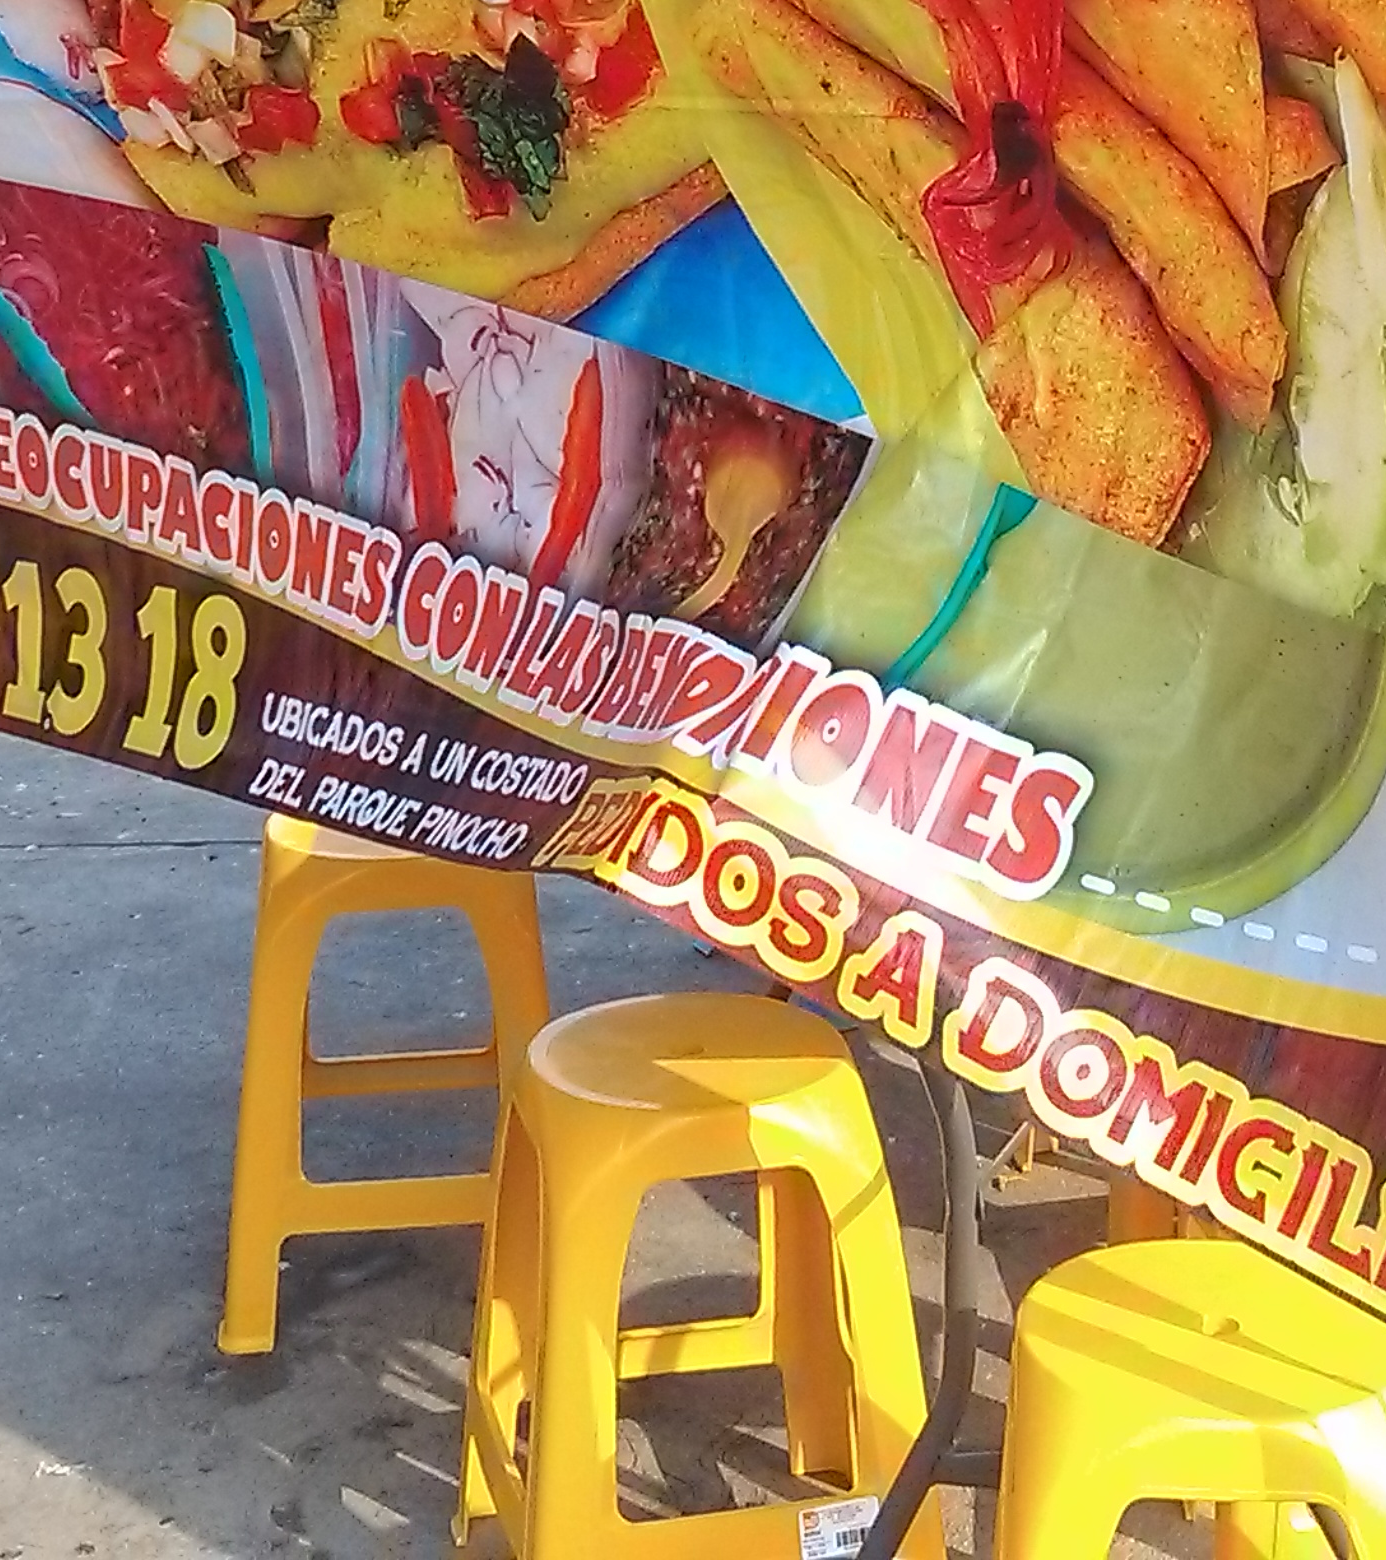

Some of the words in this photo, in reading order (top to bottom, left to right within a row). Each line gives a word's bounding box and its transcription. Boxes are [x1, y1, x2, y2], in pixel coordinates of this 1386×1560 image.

[4, 559, 108, 738] 13
[123, 584, 246, 771] 18
[402, 546, 524, 686] CON
[504, 595, 617, 721] LAS
[262, 692, 404, 767] UBICADOS
[401, 733, 428, 776] A
[430, 738, 478, 785] UN
[470, 749, 590, 805] COSTADO
[248, 758, 307, 810] DEL
[308, 776, 421, 837] PARQUE
[410, 803, 530, 861] PINOCHO
[849, 924, 935, 1034] A
